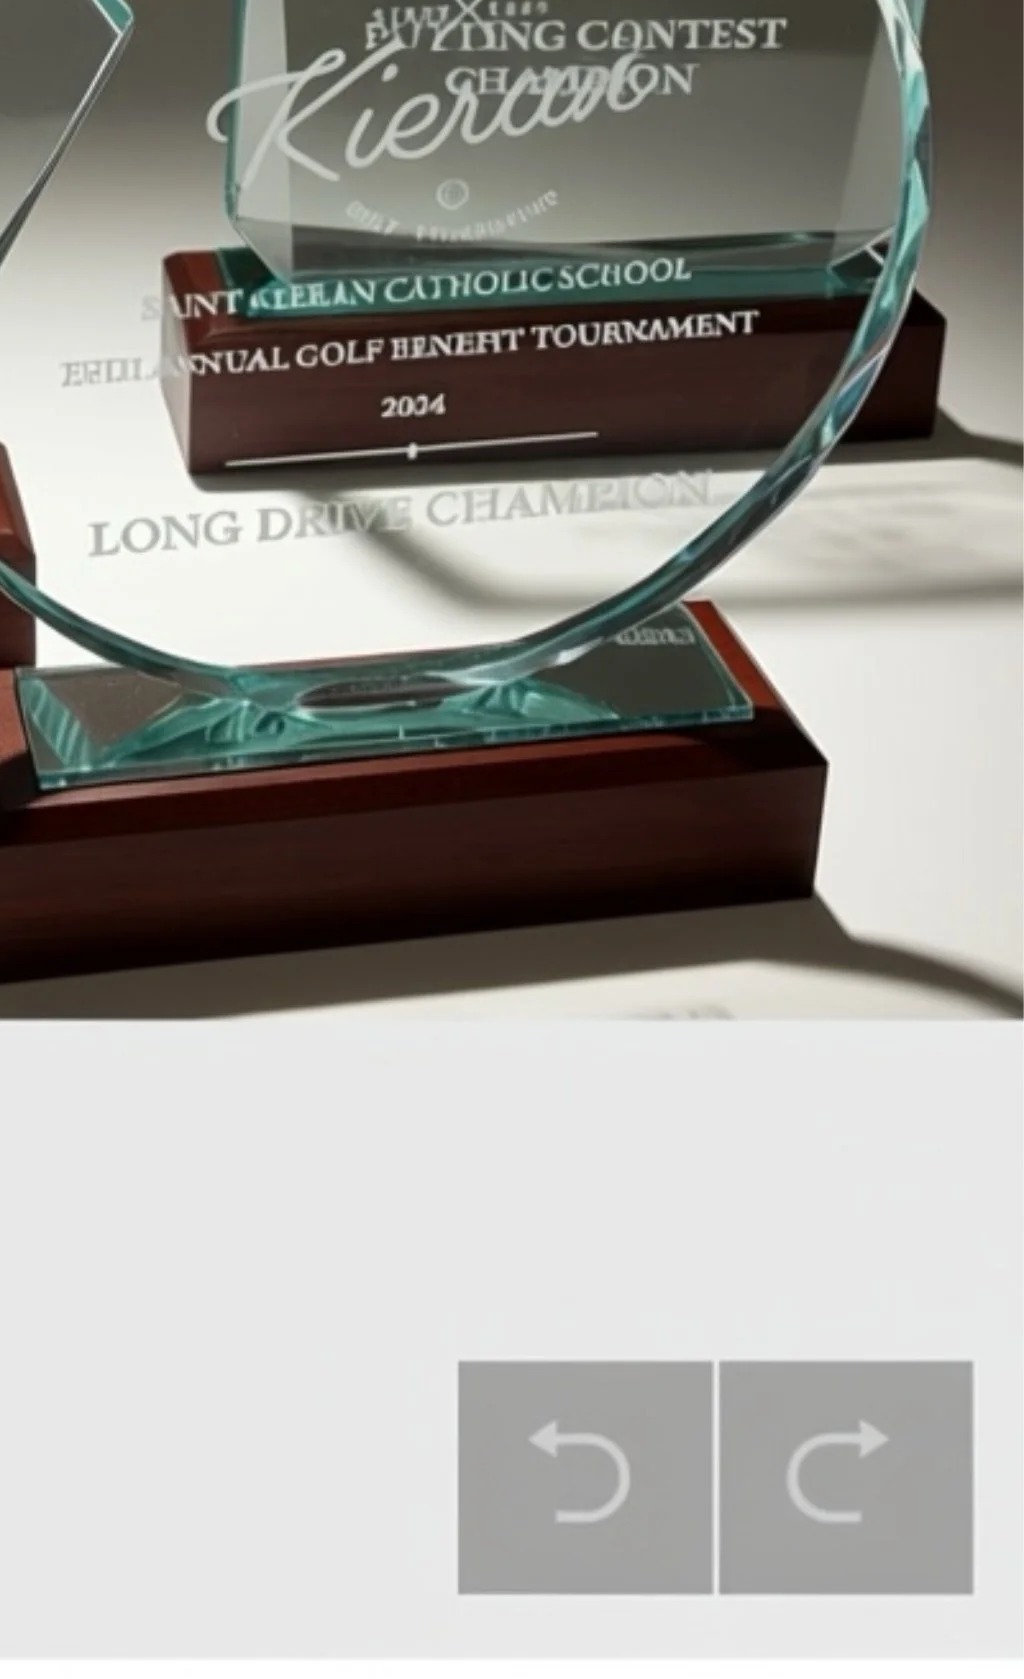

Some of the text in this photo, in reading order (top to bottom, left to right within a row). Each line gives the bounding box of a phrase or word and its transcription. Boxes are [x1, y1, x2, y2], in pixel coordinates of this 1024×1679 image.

[576, 17, 788, 52] CONTEST
[383, 266, 554, 304] CATHOLIC
[556, 256, 692, 291] SCHOOL
[295, 338, 385, 368] GOLF
[530, 309, 761, 350] TOURNAMENT
[87, 508, 244, 558] LONG
